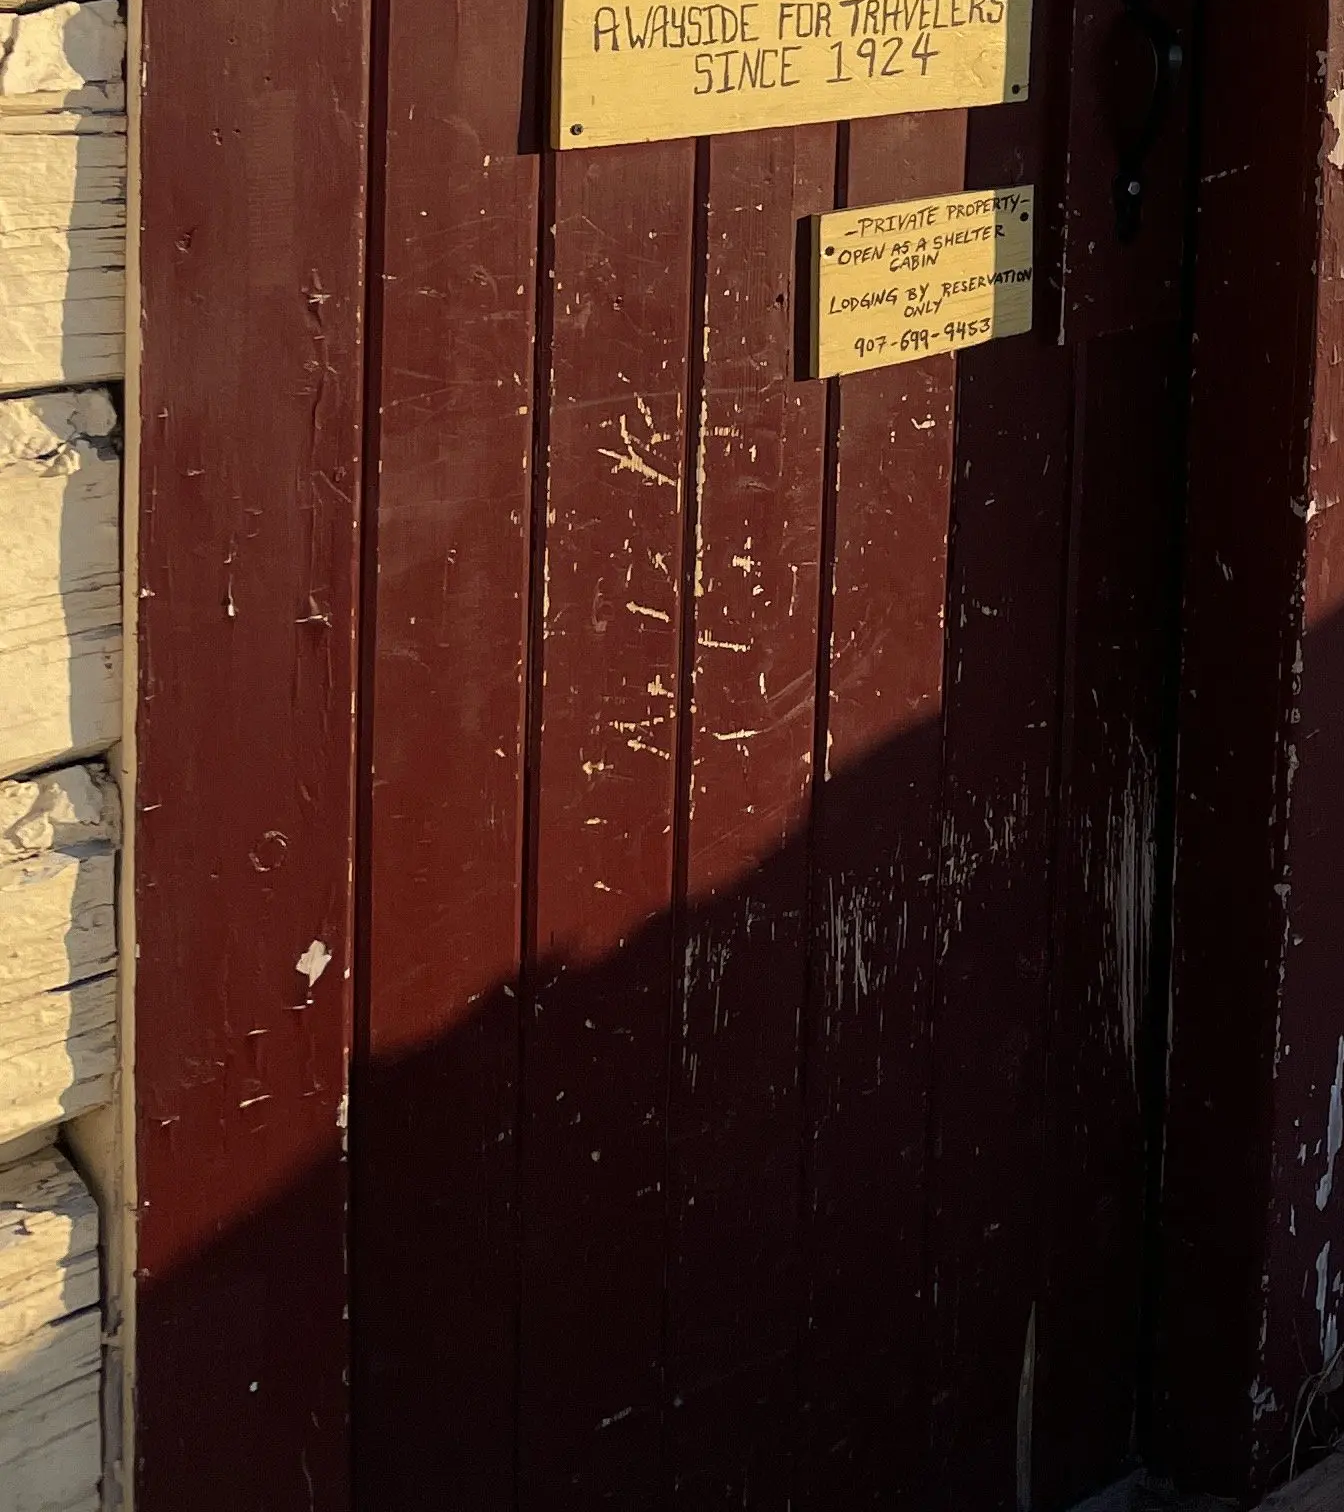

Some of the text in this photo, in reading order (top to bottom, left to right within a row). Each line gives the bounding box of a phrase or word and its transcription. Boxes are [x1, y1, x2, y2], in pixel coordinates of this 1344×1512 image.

[594, 6, 620, 52] A
[626, 4, 759, 49] WAYSIDE
[778, 1, 832, 39] FOR
[694, 32, 939, 95] SINCE 1924
[838, 224, 1005, 266] OPEN AS A SHELTER
[889, 251, 939, 272] CABIN
[828, 267, 1032, 315] LODGING BY RESERVATION
[904, 299, 944, 318] ONLY
[854, 317, 991, 357] 907-699-9453
